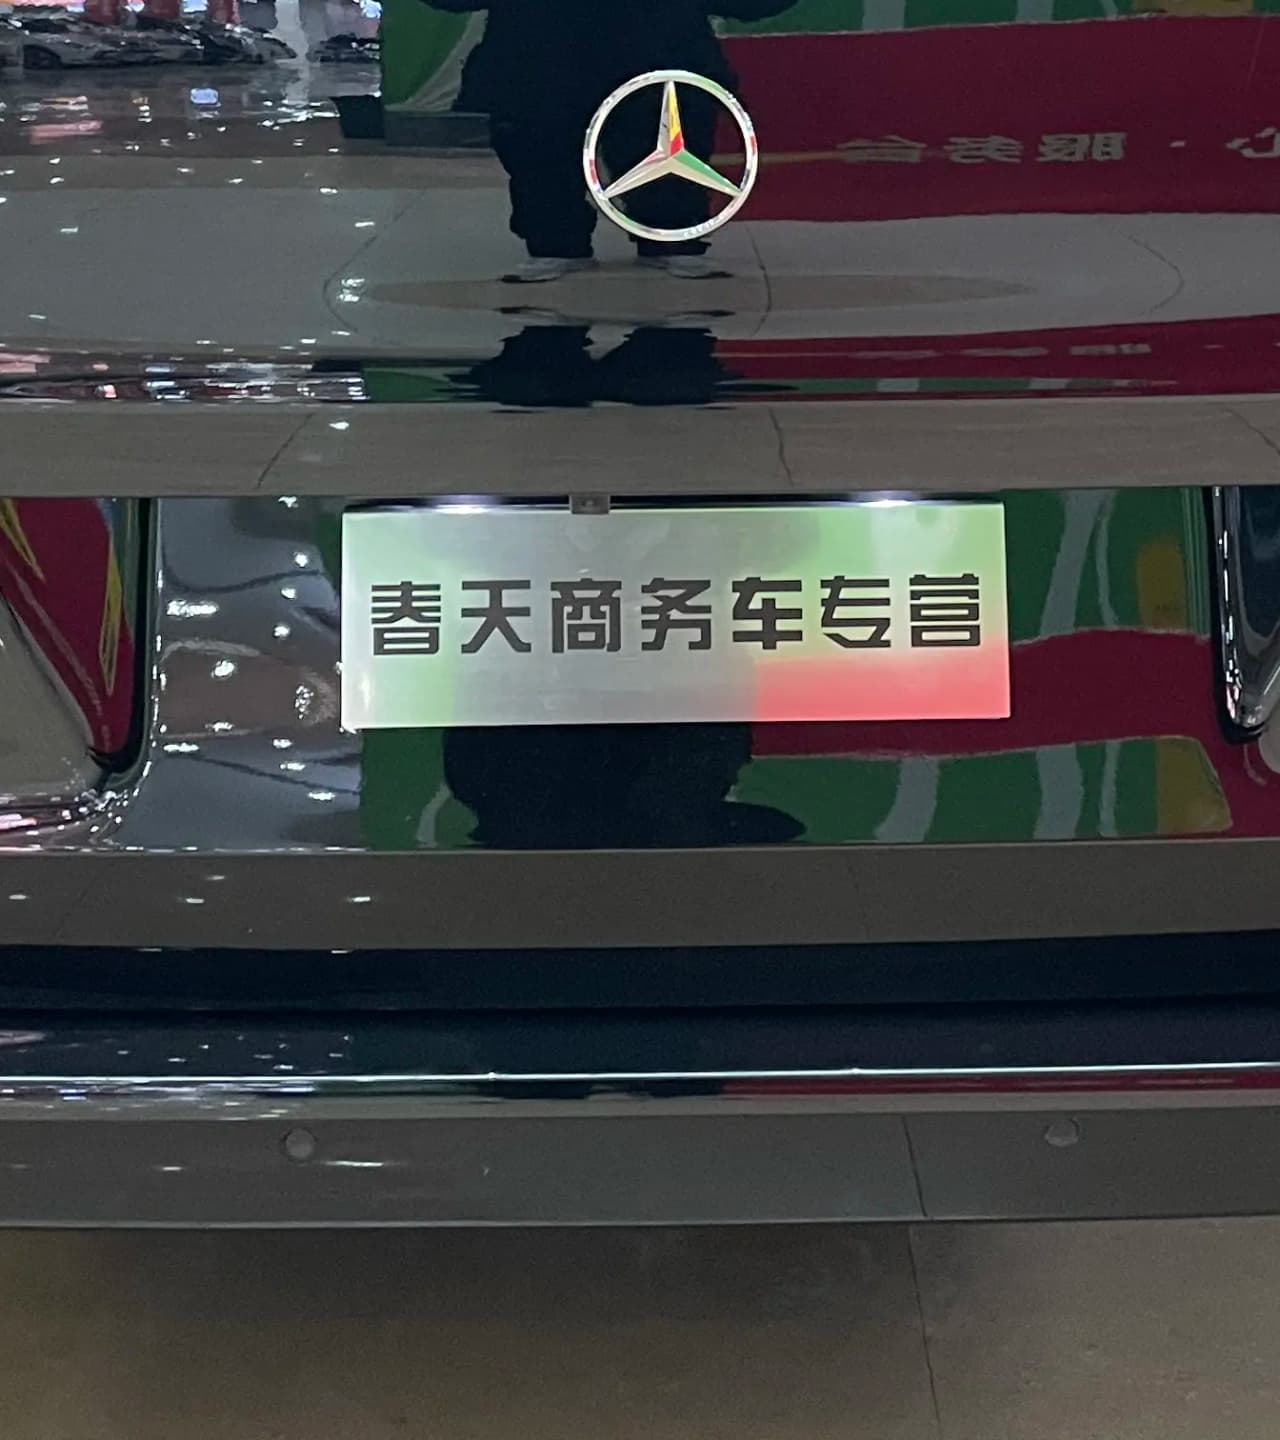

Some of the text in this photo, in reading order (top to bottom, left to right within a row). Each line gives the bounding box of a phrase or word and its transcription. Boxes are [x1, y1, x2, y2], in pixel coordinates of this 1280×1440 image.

[371, 573, 982, 656] 春天商务车专营
